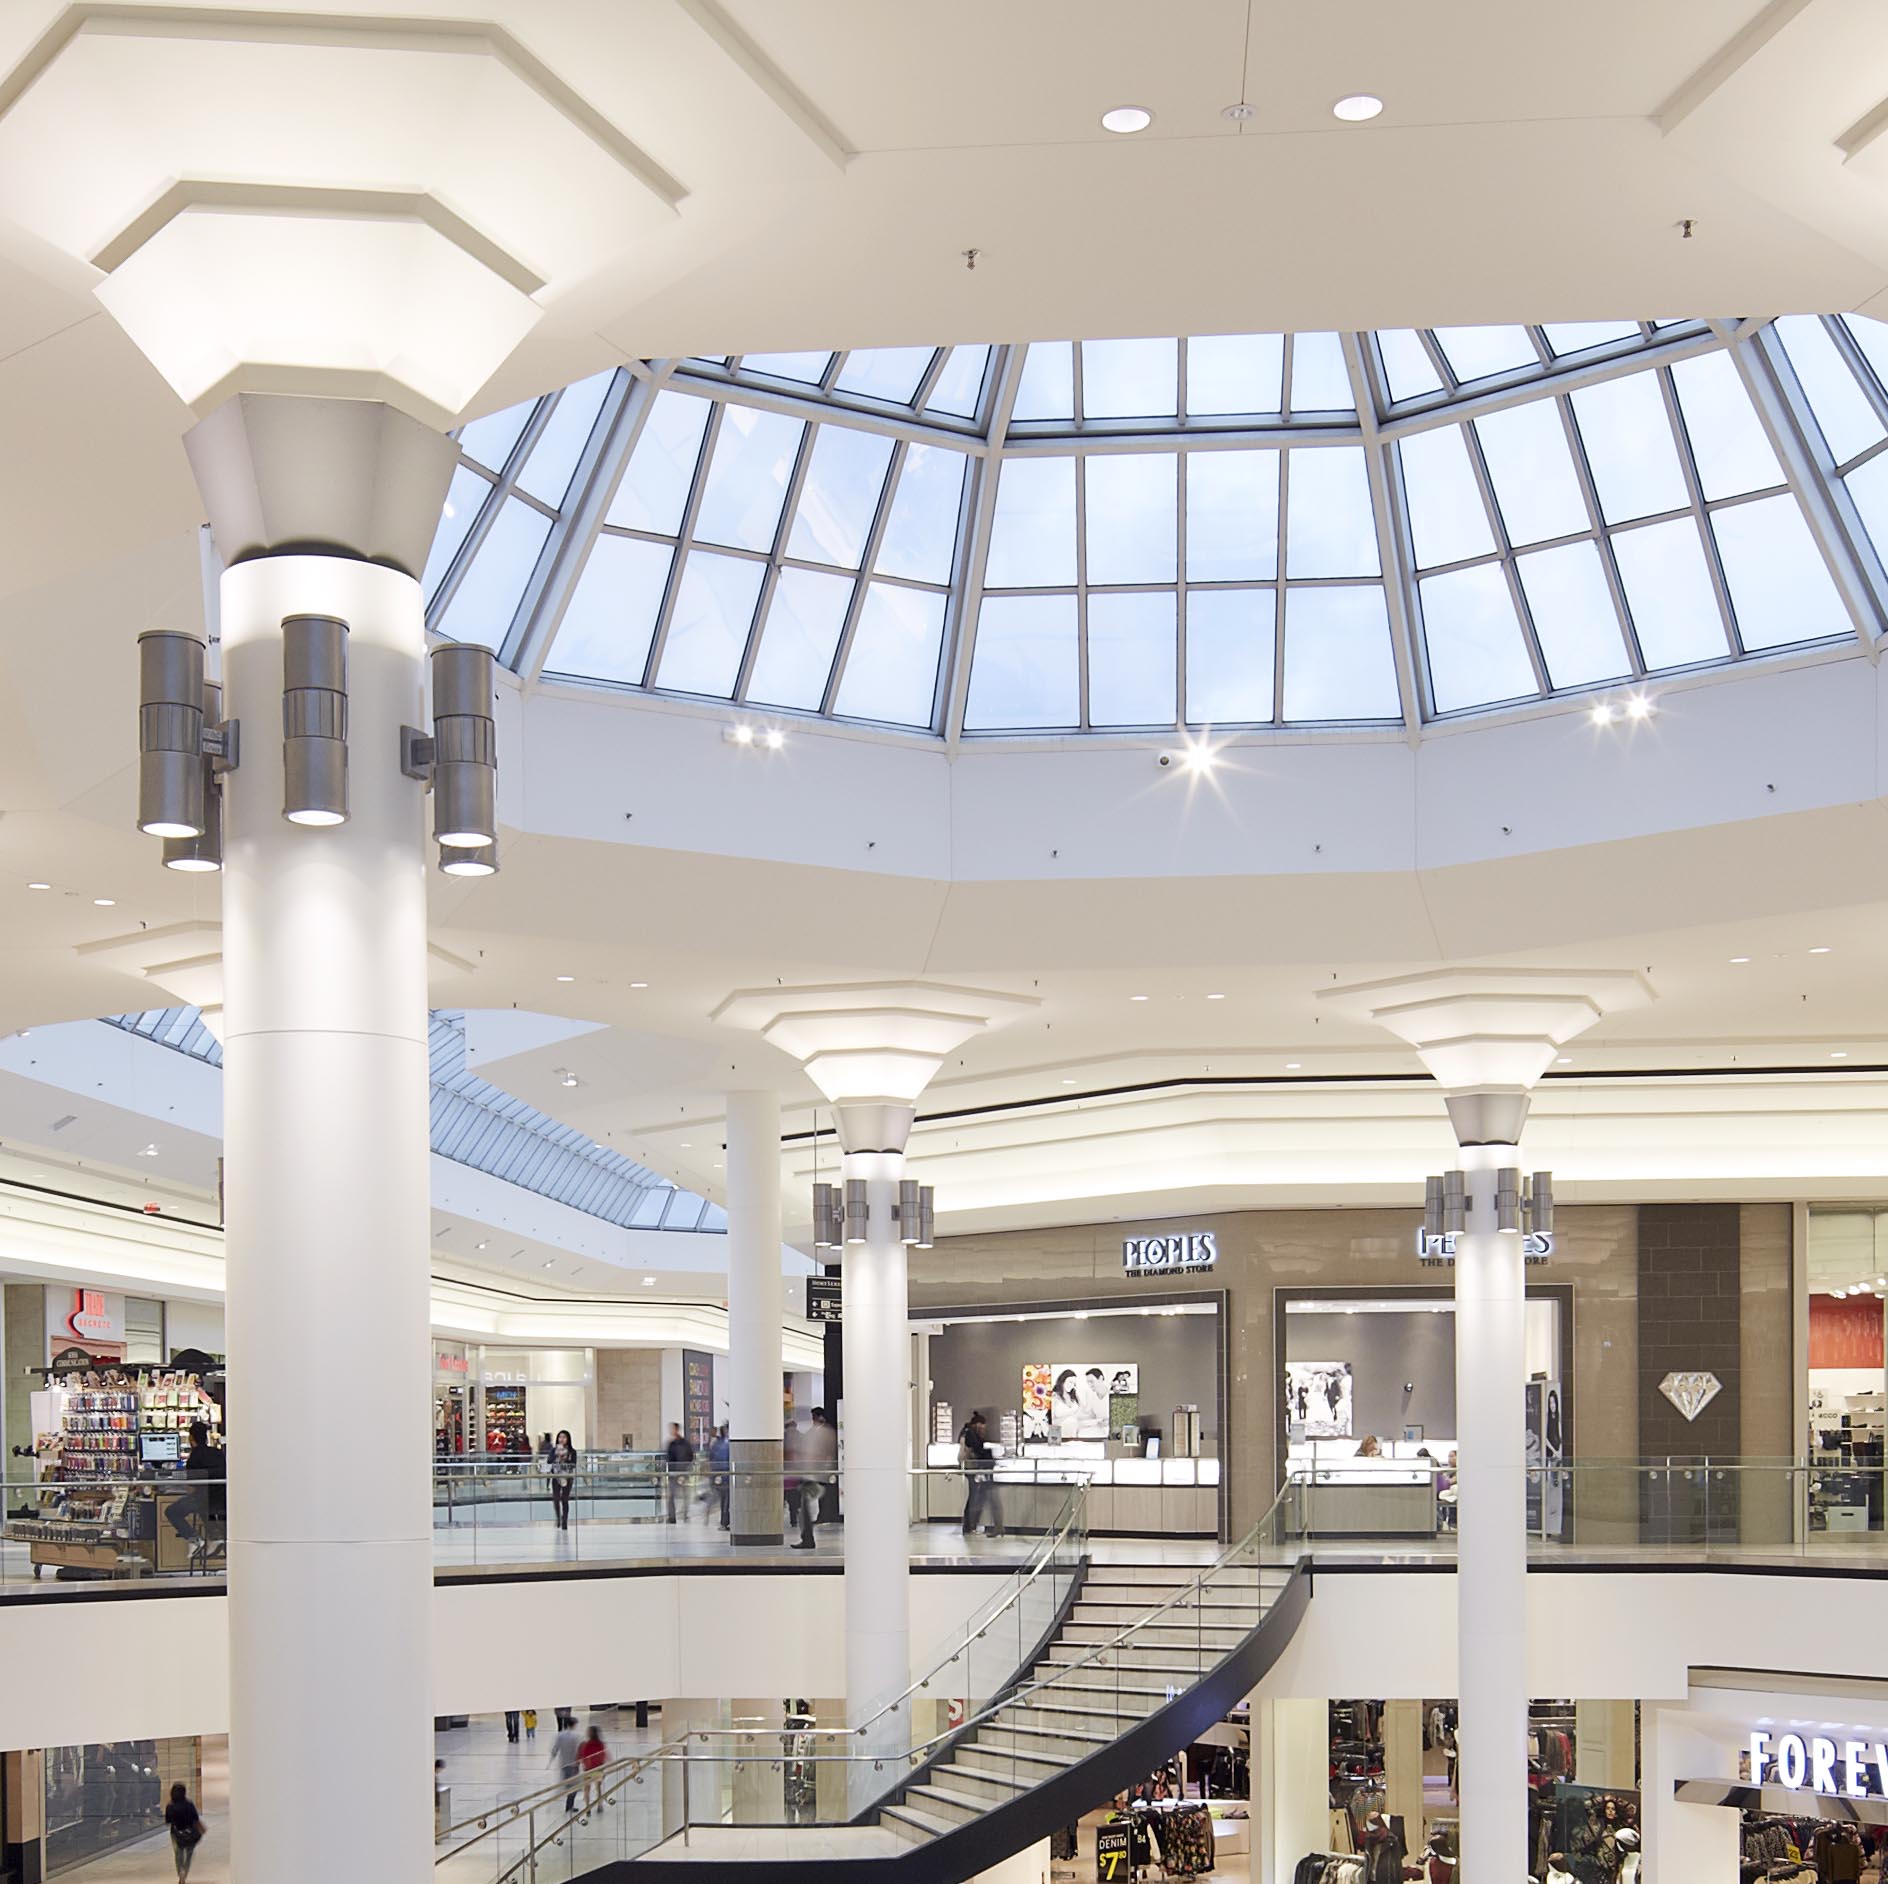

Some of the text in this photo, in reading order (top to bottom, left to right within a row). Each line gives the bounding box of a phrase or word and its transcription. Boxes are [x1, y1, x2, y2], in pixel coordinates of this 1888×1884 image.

[1123, 1235, 1212, 1266] PEOPLES
[1144, 1267, 1184, 1276] DIAMOND
[1099, 1837, 1127, 1850] DENIM
